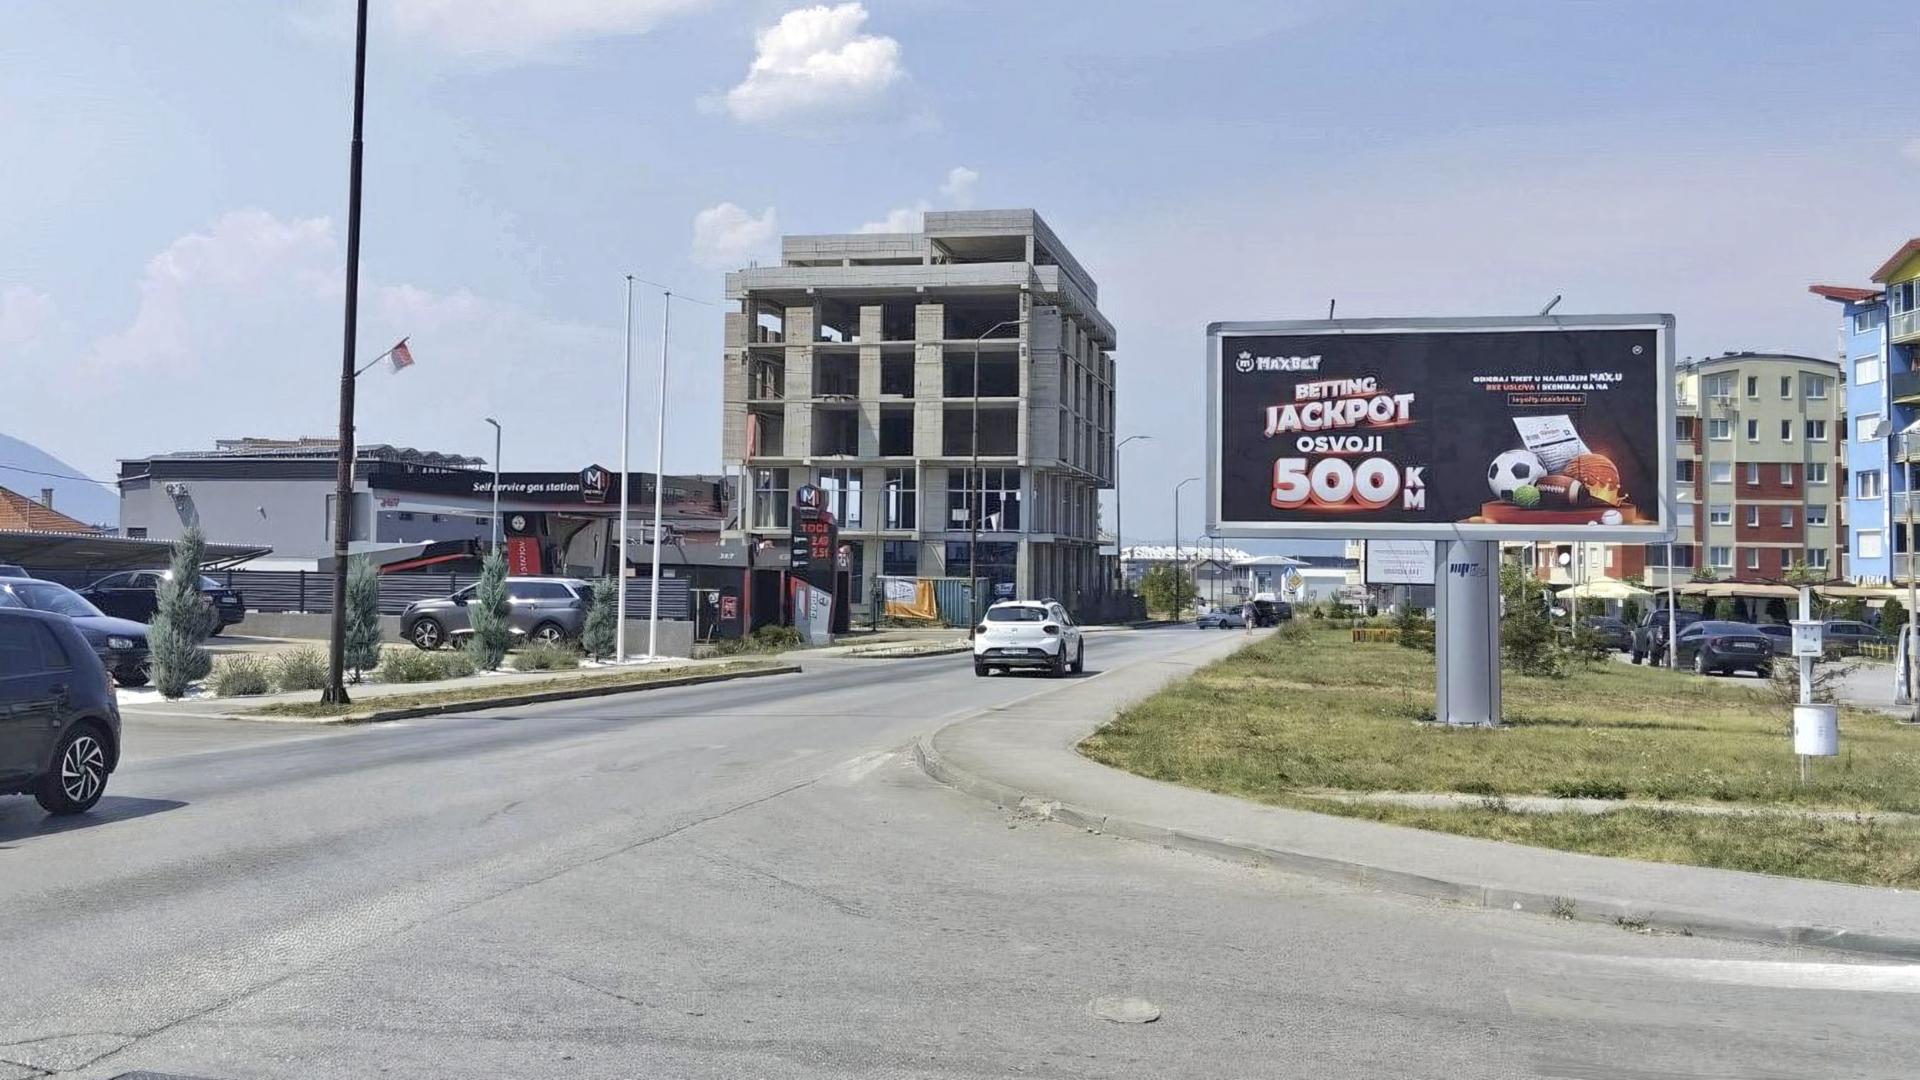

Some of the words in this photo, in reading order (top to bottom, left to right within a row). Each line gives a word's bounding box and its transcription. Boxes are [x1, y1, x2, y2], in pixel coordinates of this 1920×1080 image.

[1295, 377, 1377, 400] BETTING
[1265, 393, 1414, 437] JACKPOT
[1296, 436, 1382, 452] OSVOJI
[473, 482, 492, 491] Self
[527, 484, 544, 493] gas
[545, 482, 579, 491] station
[1273, 457, 1400, 506] 500
